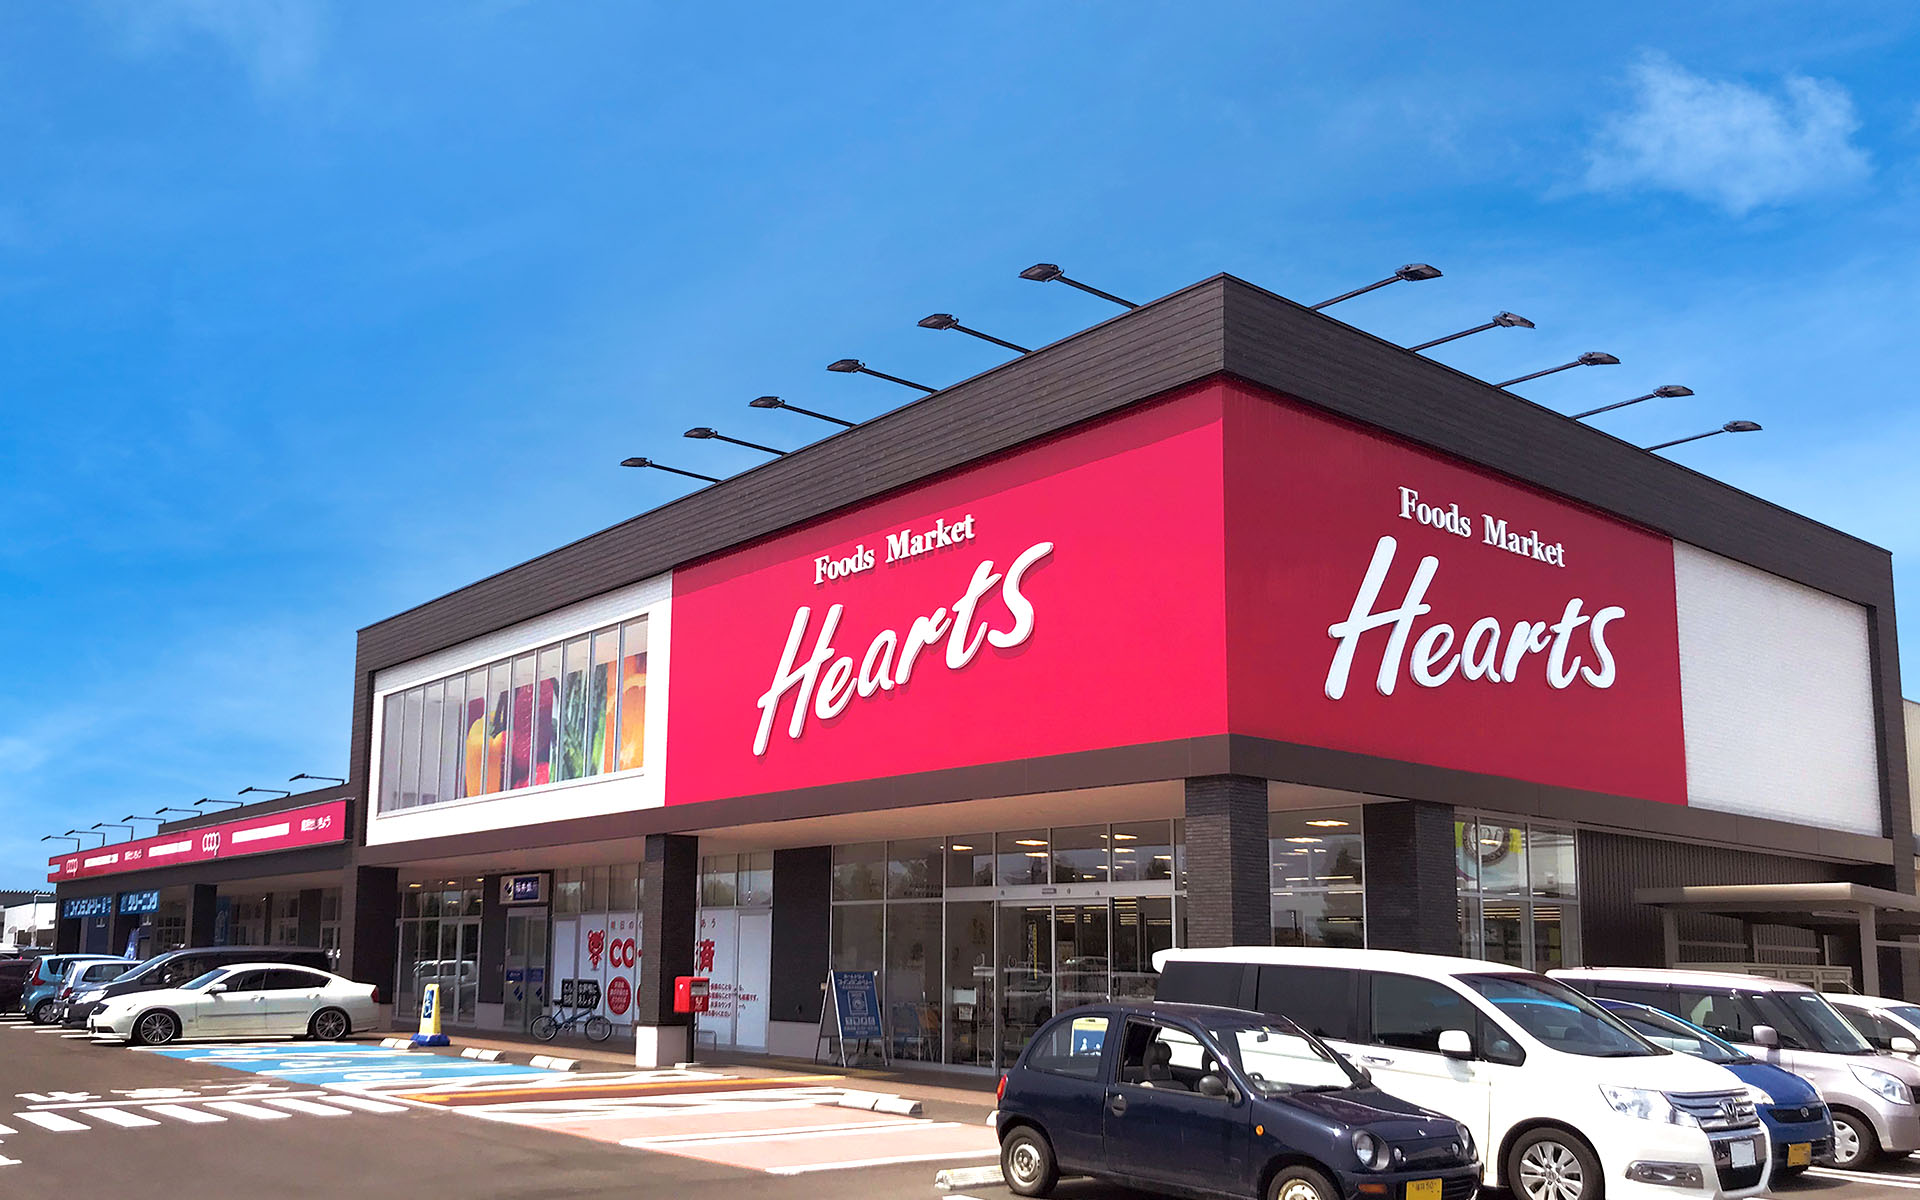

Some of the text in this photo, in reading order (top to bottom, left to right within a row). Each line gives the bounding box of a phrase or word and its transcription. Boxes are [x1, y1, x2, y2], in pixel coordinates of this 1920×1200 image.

[813, 513, 975, 585] Foods Market
[1398, 486, 1566, 568] Foods Market
[752, 541, 1054, 756] Hearts
[1324, 535, 1626, 700] Hearts
